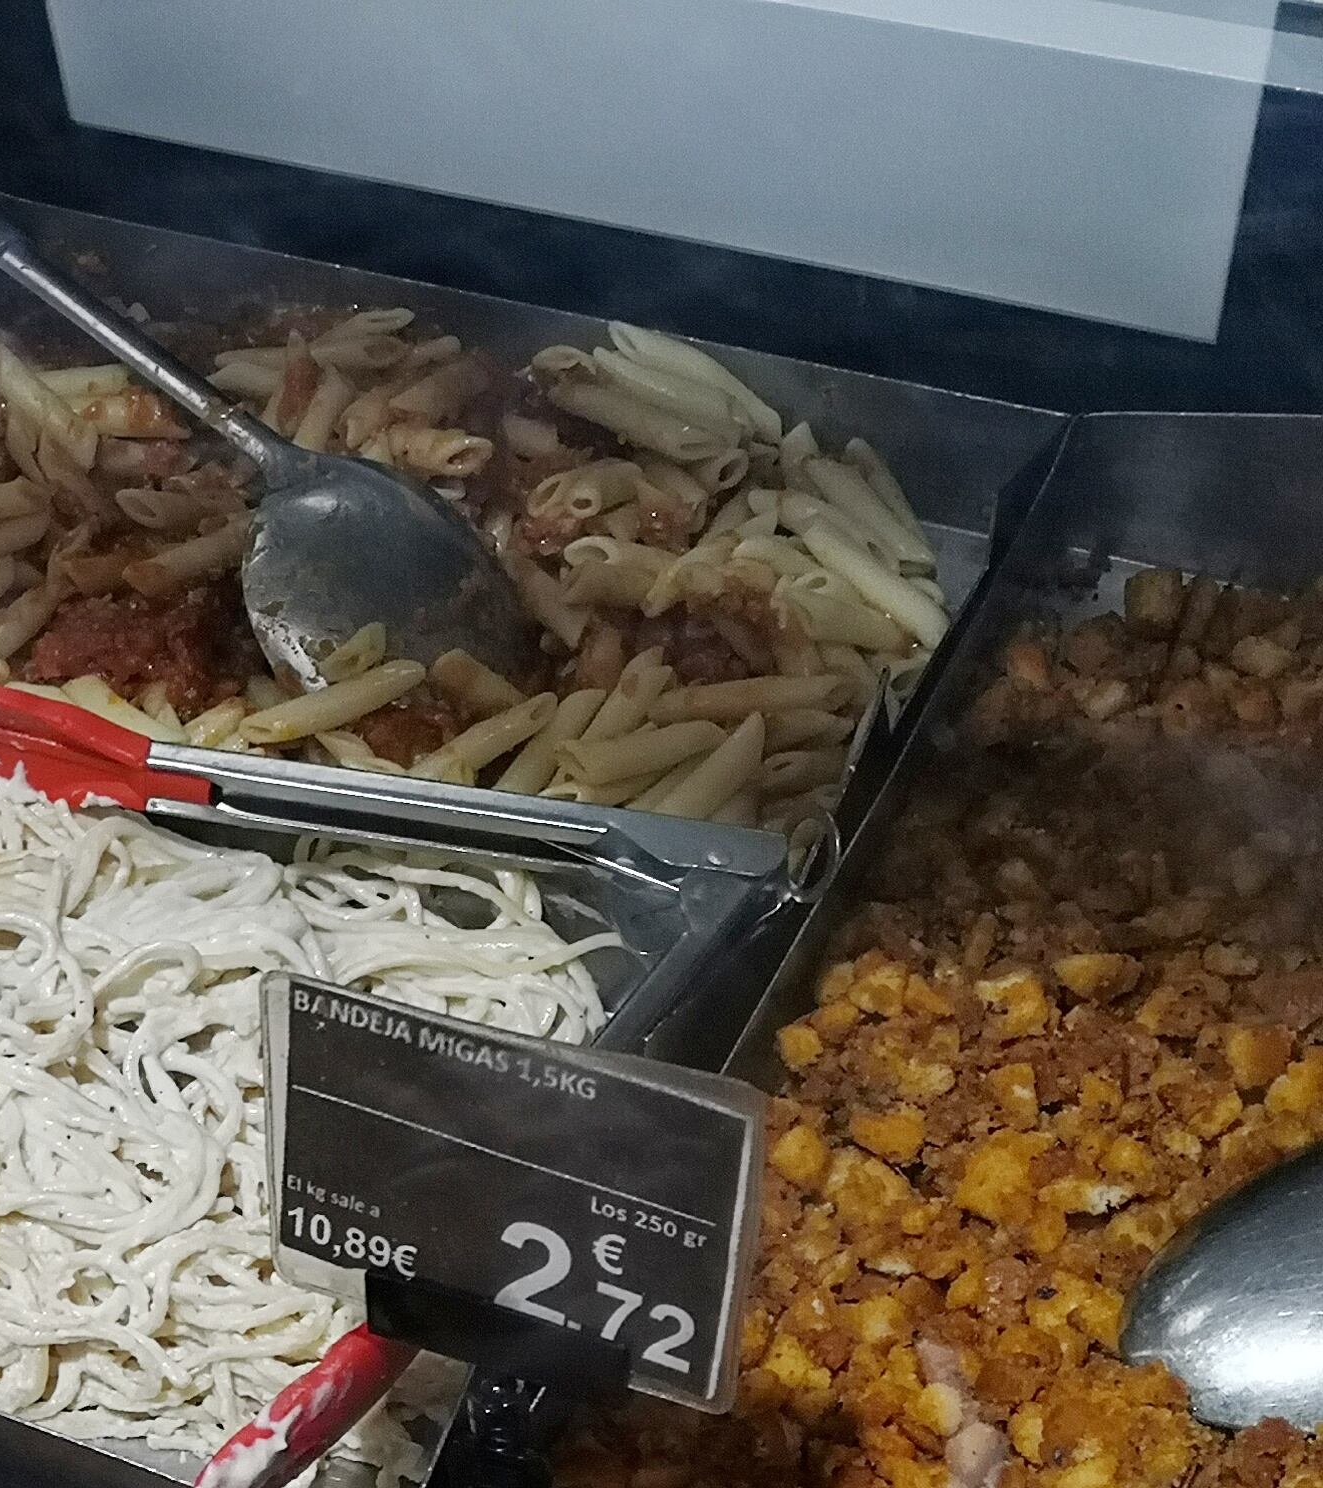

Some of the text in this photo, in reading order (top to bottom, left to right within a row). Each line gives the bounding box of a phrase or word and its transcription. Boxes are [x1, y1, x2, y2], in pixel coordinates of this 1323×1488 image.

[418, 1026, 510, 1074] MIGAS
[516, 1057, 598, 1101] 1,5KG
[286, 1173, 382, 1219] El kg sale a
[591, 1196, 708, 1249] Los 250 gr
[287, 1206, 419, 1279] 10,89€
